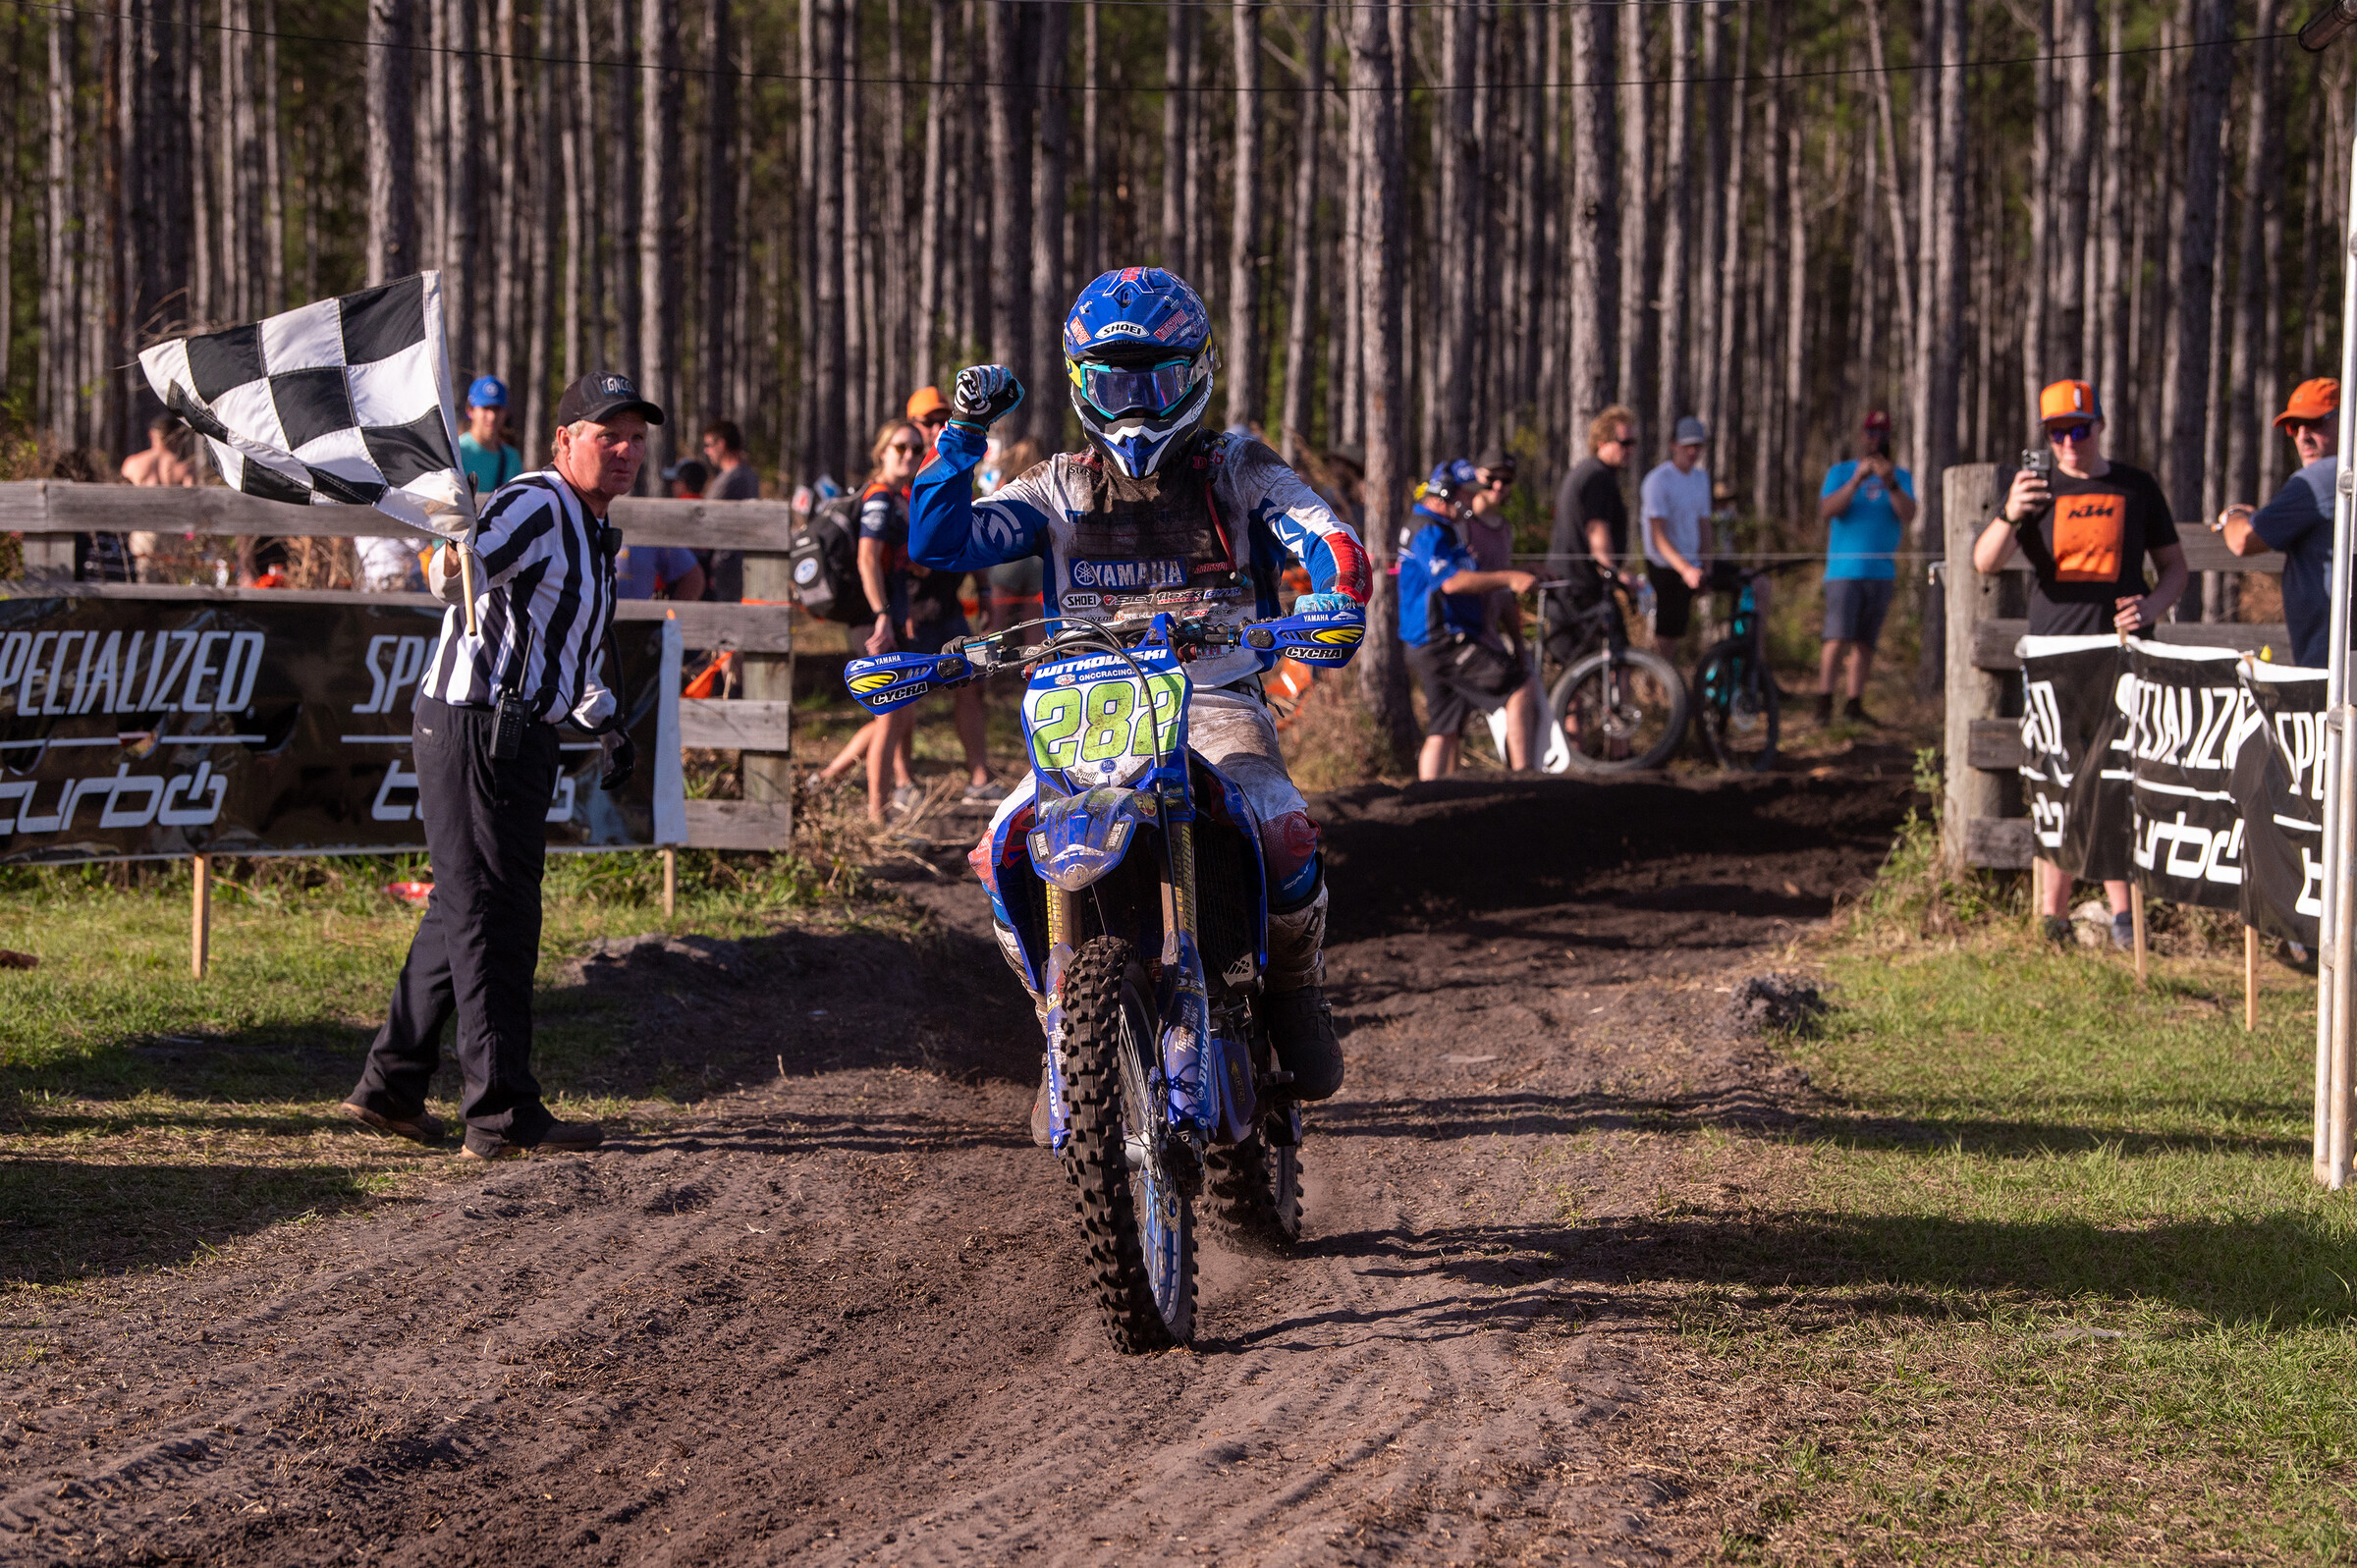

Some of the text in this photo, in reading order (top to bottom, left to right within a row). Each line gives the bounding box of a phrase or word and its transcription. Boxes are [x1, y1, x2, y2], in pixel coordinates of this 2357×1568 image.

[1103, 323, 1142, 336] SHOEI
[2067, 505, 2115, 519] KTM
[1090, 561, 1183, 587] YAMAHA
[1067, 595, 1097, 607] SHOEI
[1303, 614, 1330, 622] YAMAHA
[874, 654, 902, 666] YAMAHA
[1285, 646, 1343, 660] CYCRA
[872, 681, 929, 706] CYCRA
[1032, 673, 1186, 770] 282
